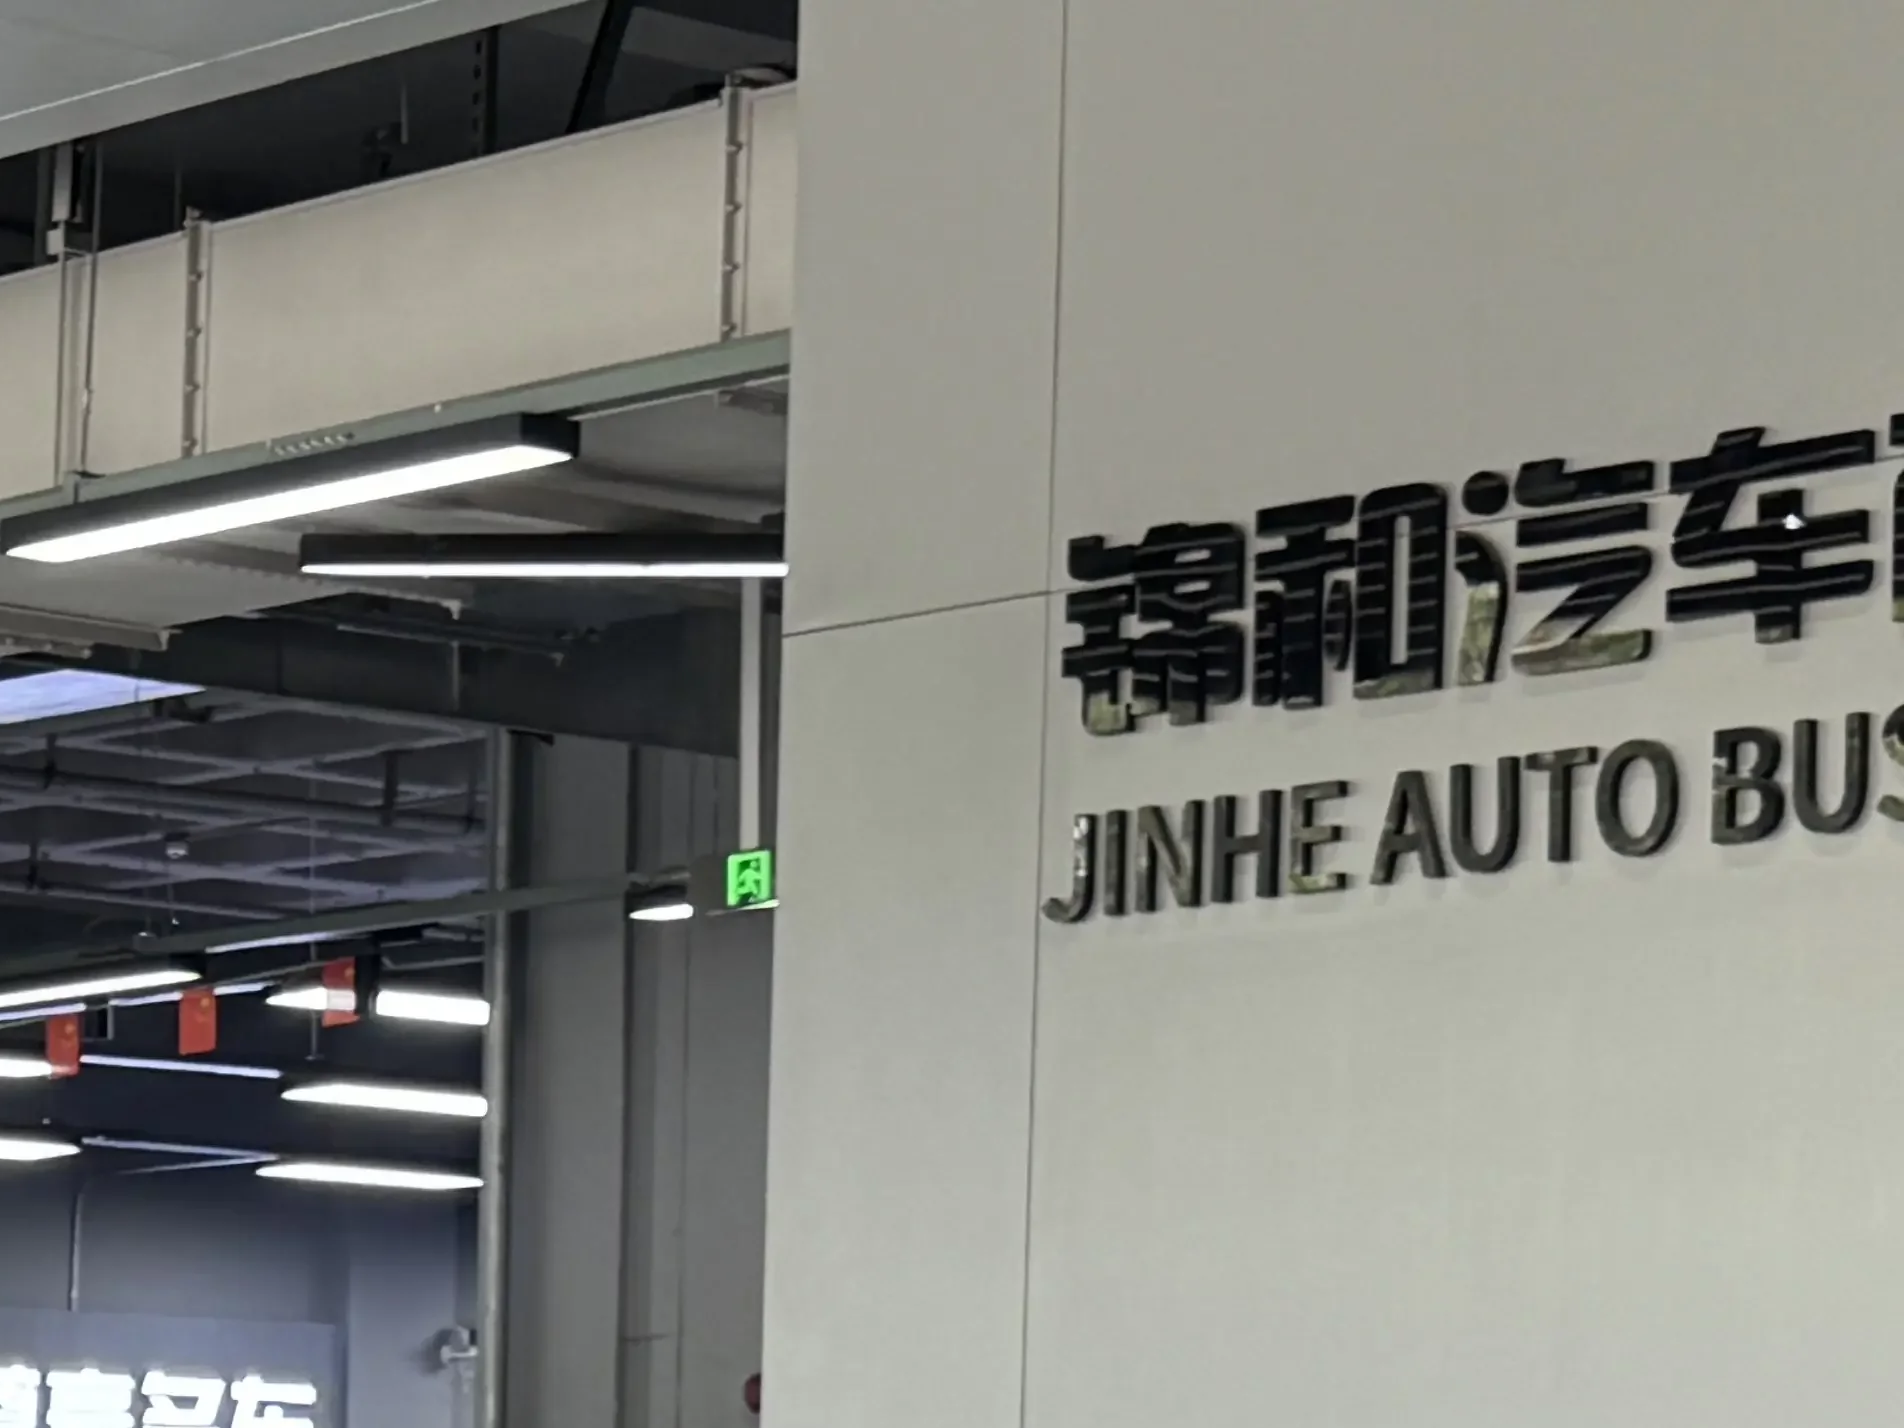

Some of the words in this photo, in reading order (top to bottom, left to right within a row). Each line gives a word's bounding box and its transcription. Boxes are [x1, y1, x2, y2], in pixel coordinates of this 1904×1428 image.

[1062, 413, 1904, 736] 锦和汽车
[1043, 779, 1348, 923] JINHE
[1369, 739, 1683, 884] AUTO
